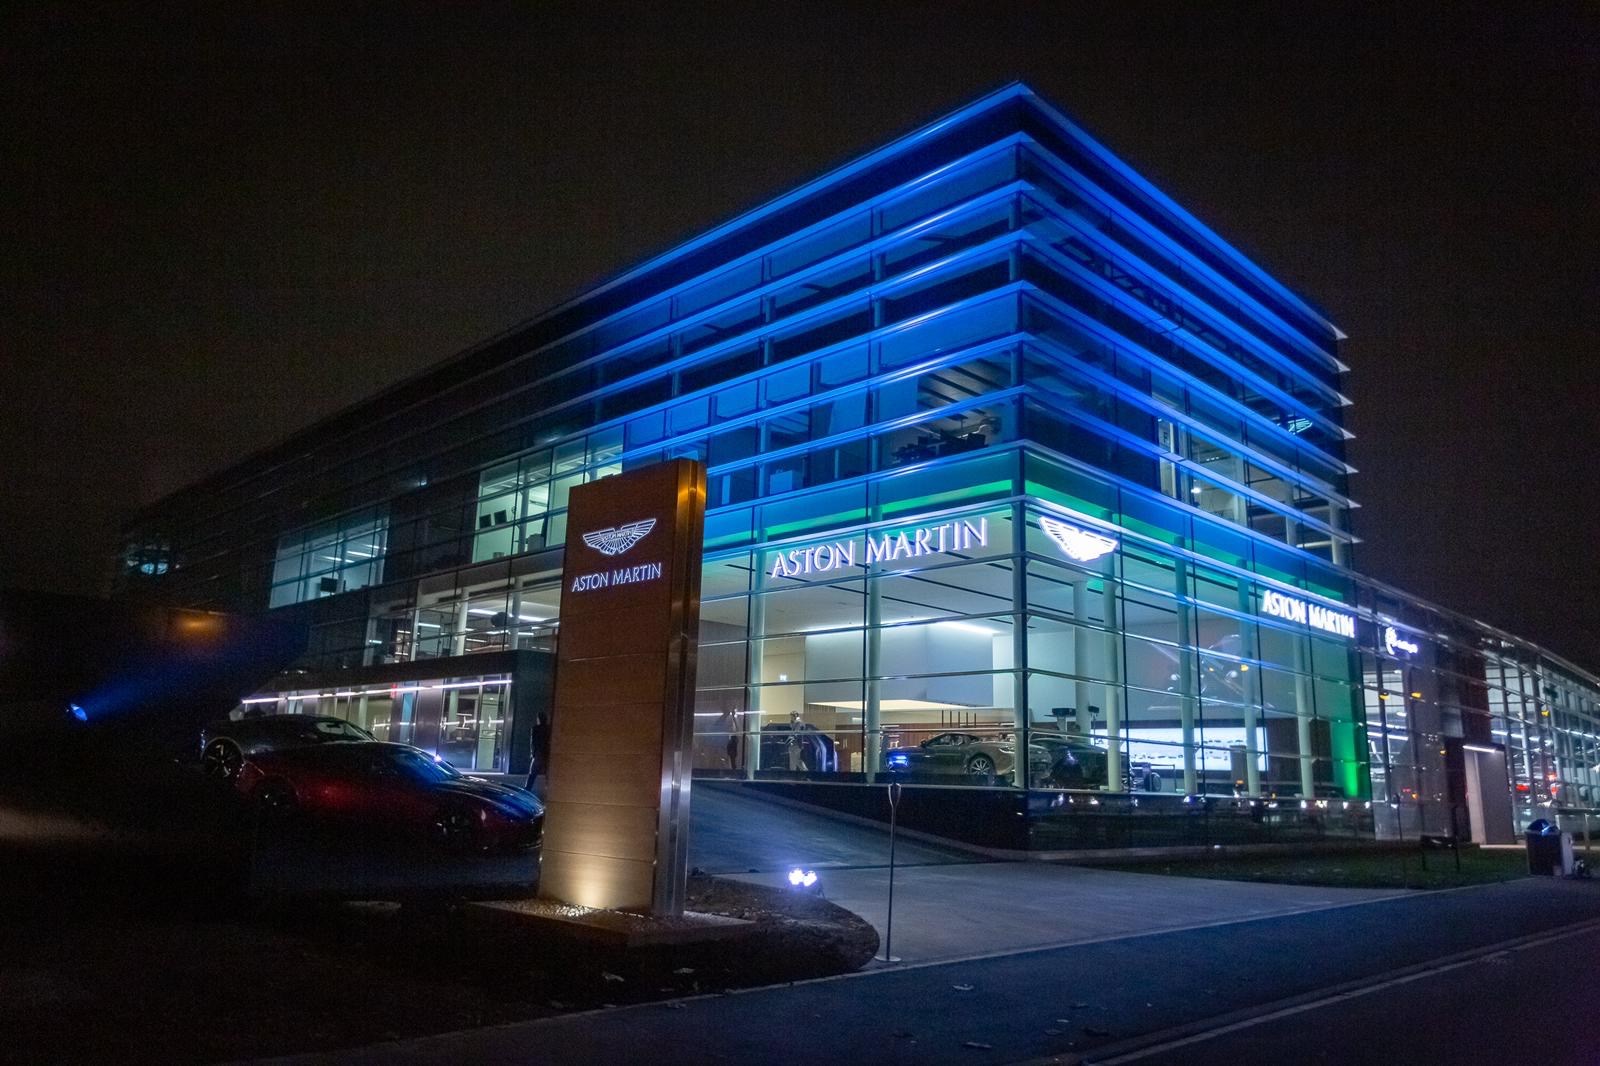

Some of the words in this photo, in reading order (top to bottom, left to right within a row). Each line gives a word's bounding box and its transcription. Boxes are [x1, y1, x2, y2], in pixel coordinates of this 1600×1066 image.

[771, 540, 856, 578] ASTON
[865, 517, 988, 564] MARTIN
[572, 572, 609, 592] ASTON
[612, 562, 661, 586] MARTIN
[1262, 589, 1306, 624] ASTON
[1308, 603, 1355, 638] MARTIN
